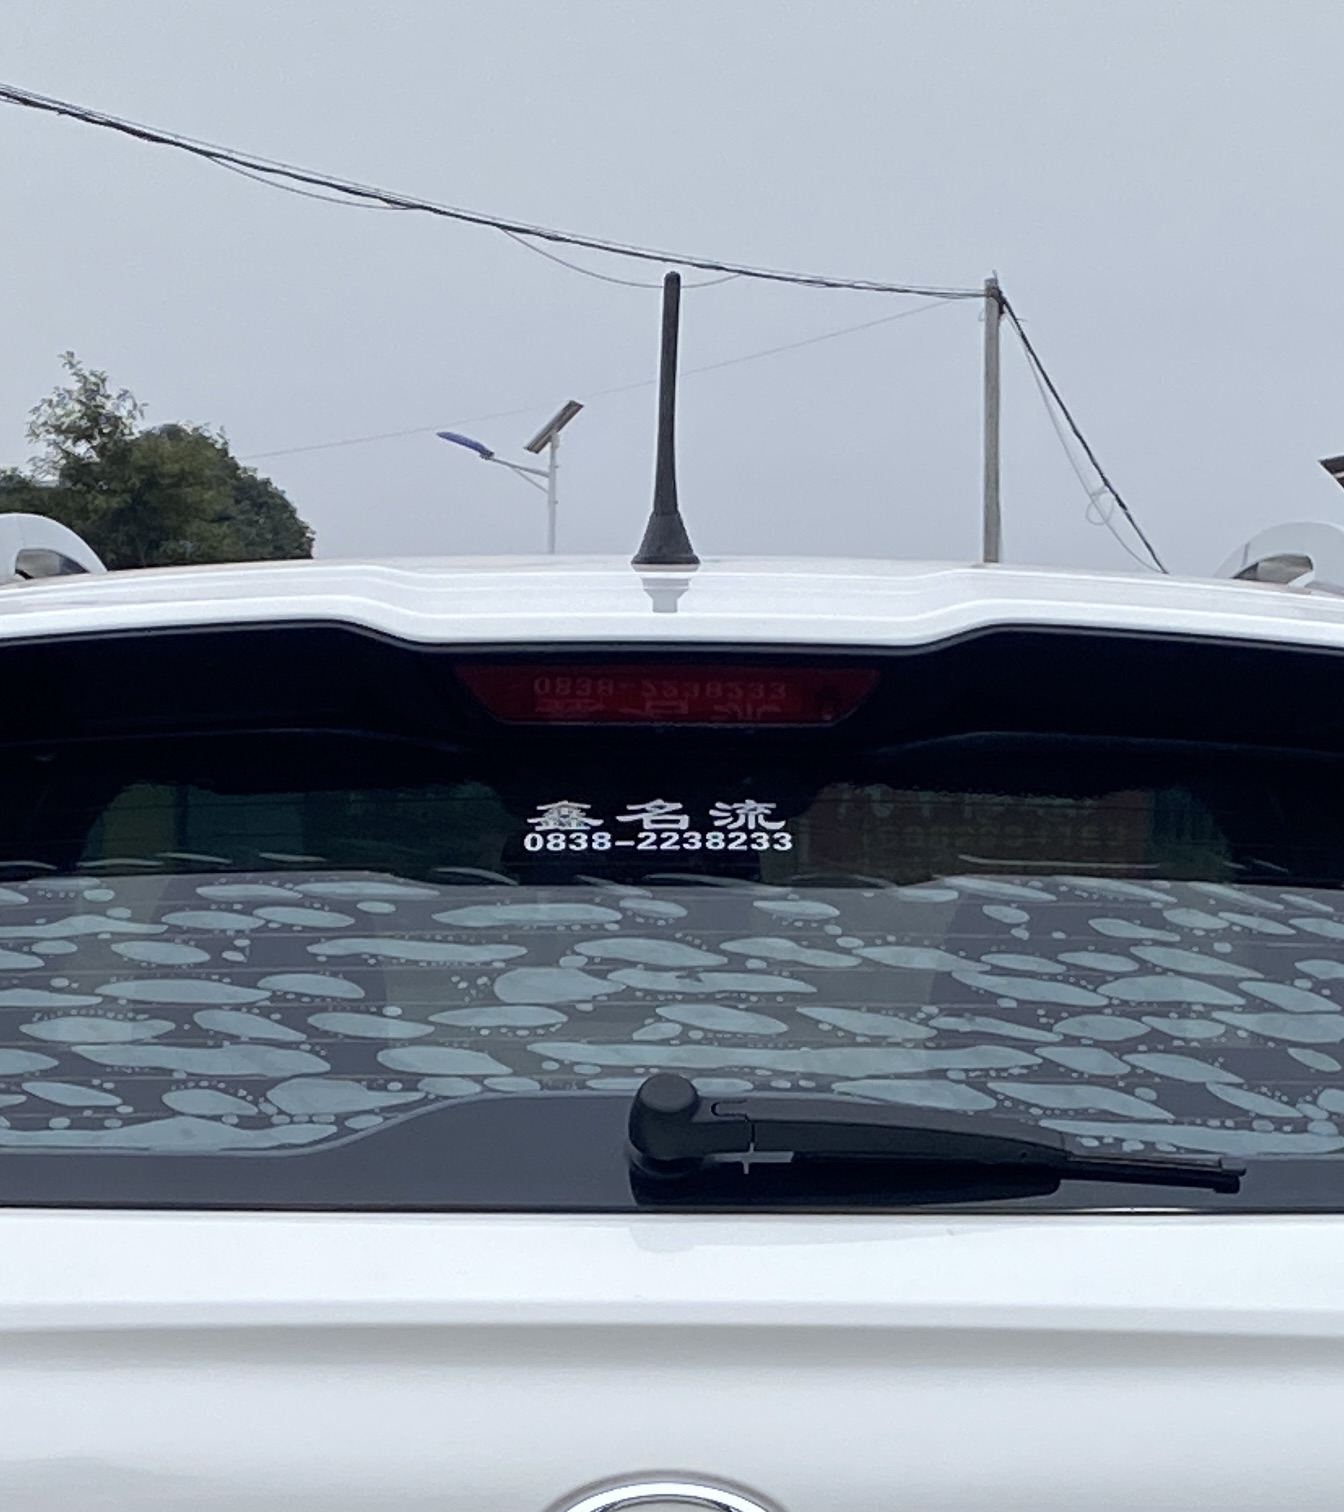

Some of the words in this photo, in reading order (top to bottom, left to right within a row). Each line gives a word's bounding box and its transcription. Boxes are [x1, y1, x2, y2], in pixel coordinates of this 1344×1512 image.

[526, 798, 787, 831] 鑫名流
[523, 831, 794, 852] 0838-2238233
